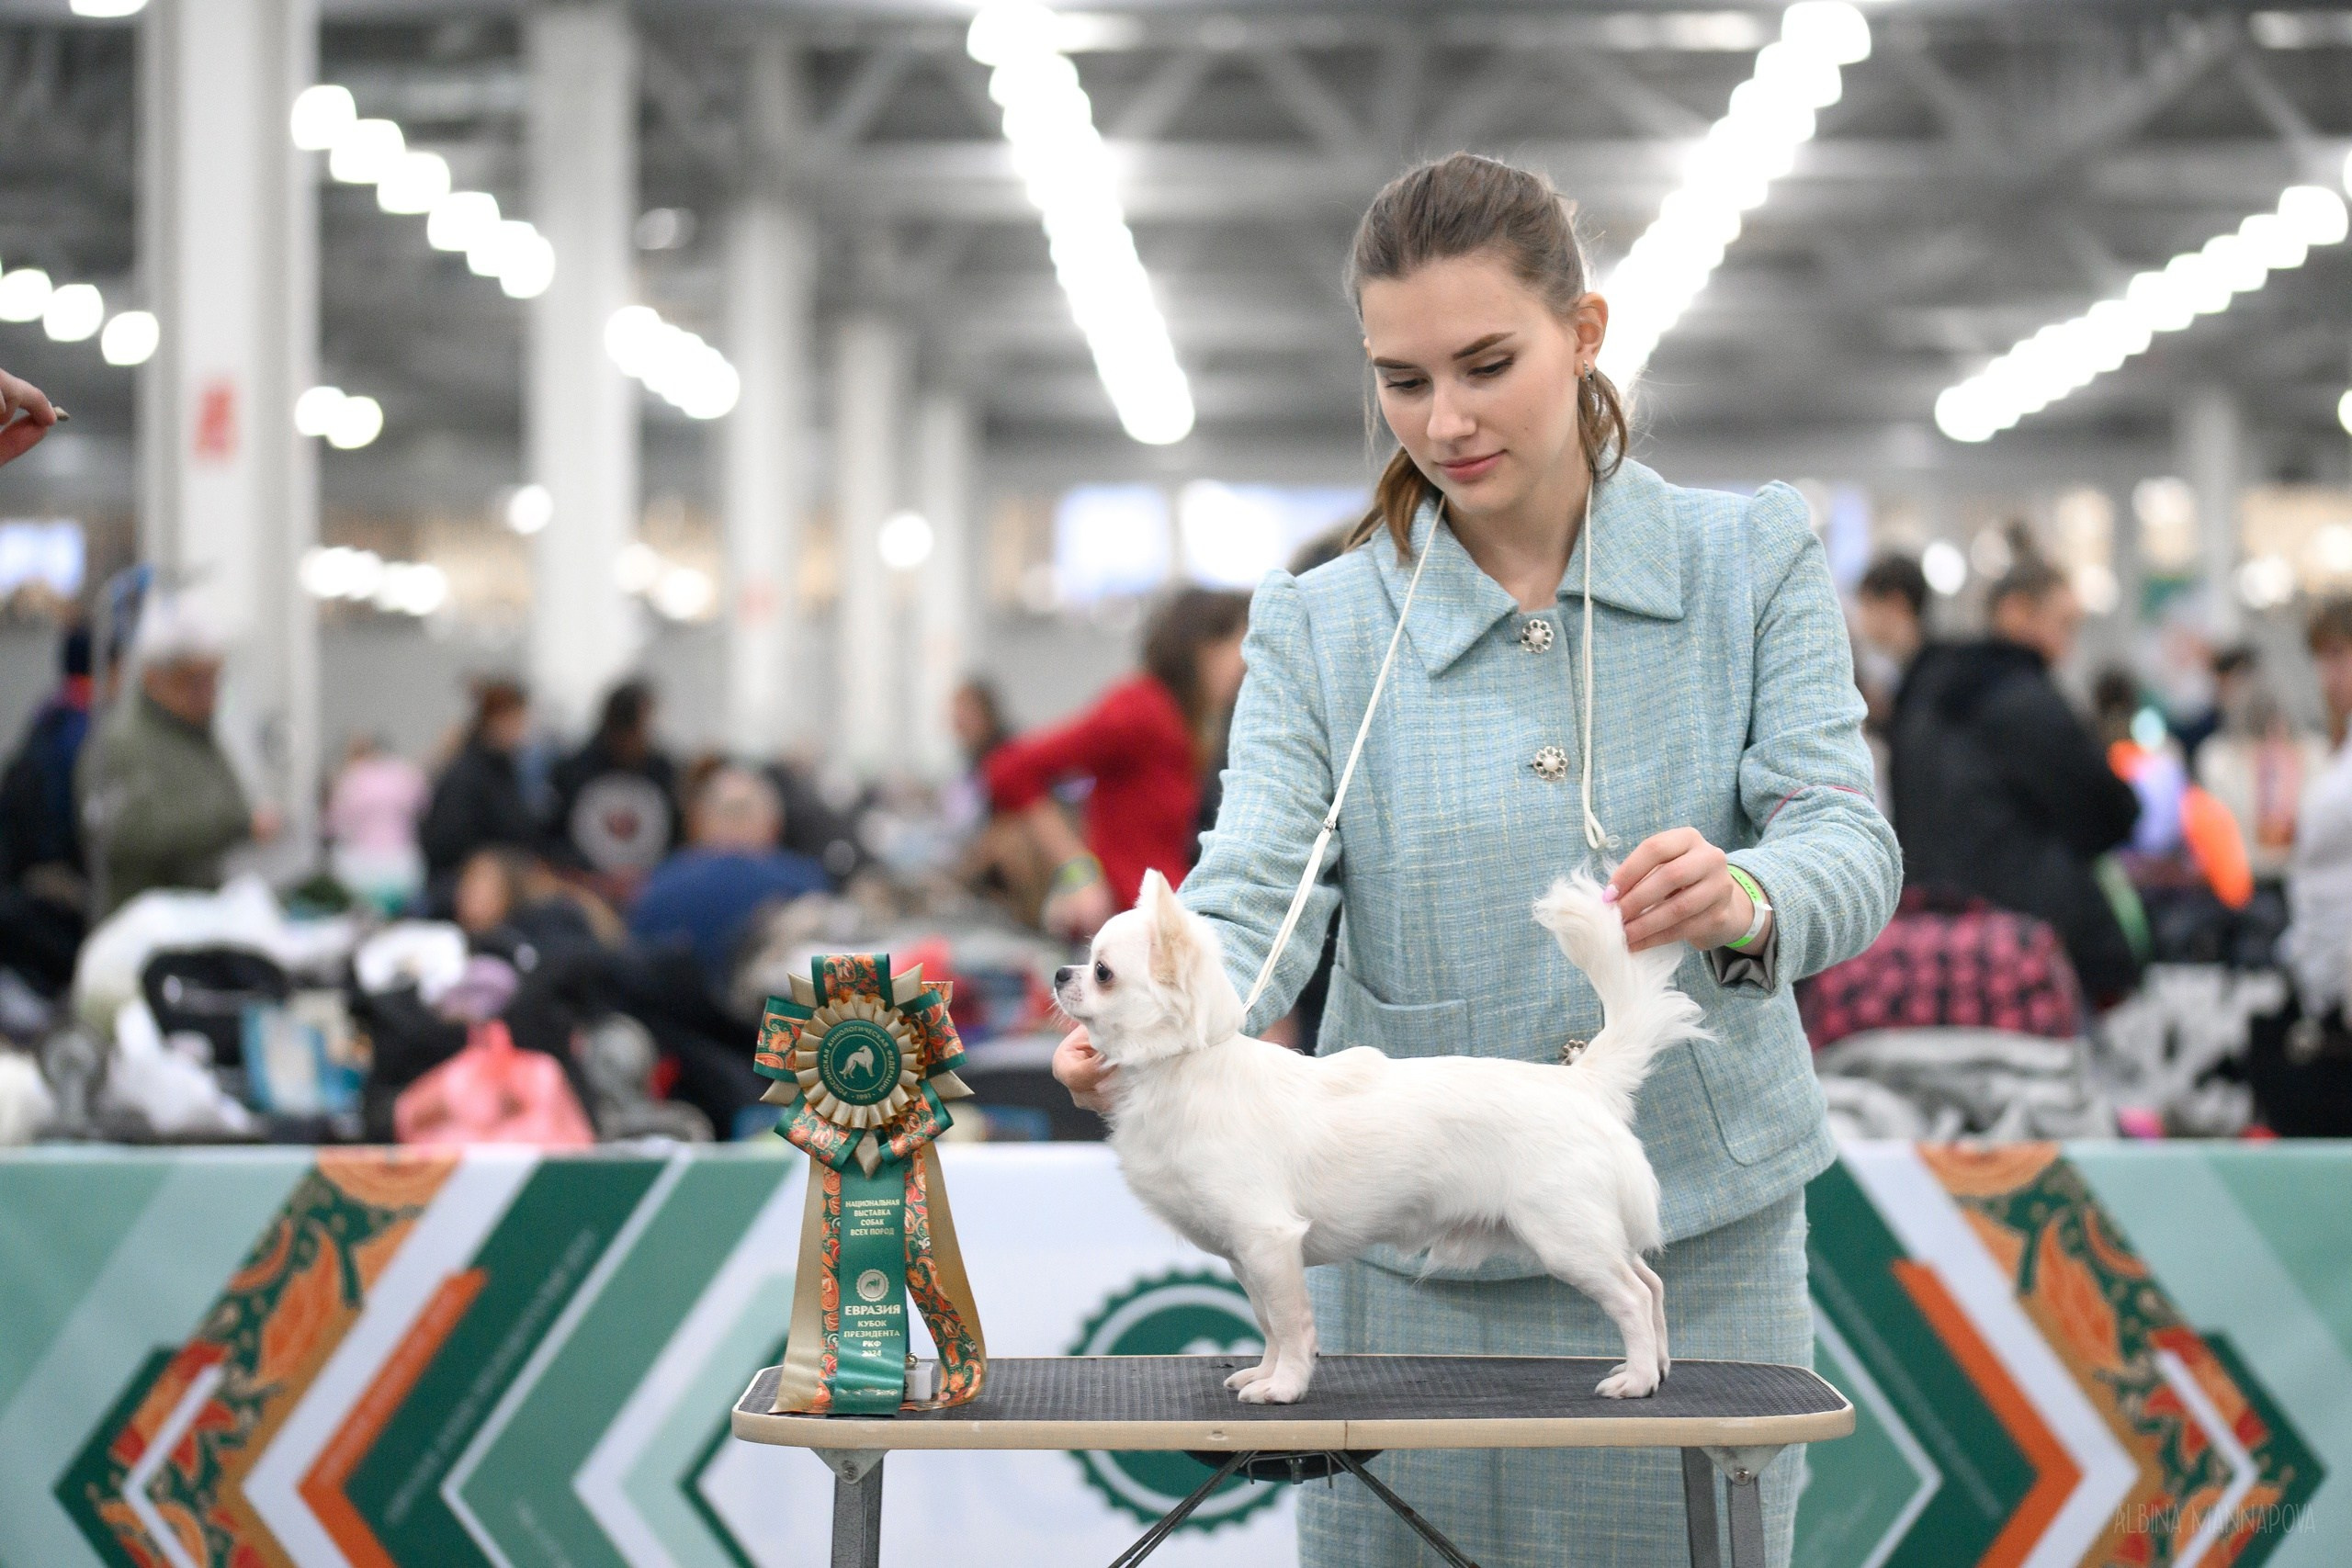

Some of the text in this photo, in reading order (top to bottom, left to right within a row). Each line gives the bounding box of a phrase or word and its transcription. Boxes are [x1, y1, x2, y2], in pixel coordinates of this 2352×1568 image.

[828, 1025, 889, 1047] КИНОЛОГИЧЕСКАЯ
[877, 1049, 896, 1093] ФЕДЕРАЦИЯ
[845, 1199, 900, 1208] НАЦИОНАЛЬНАЯ
[854, 1209, 891, 1217] ВЫСТАВКА
[860, 1218, 885, 1226] СОБАК
[850, 1227, 895, 1236] ВСЕХ ПОРОД
[844, 1304, 901, 1316] ЕВРАЗИЯ
[843, 1329, 900, 1338] ПРЕЗИДЕНТА
